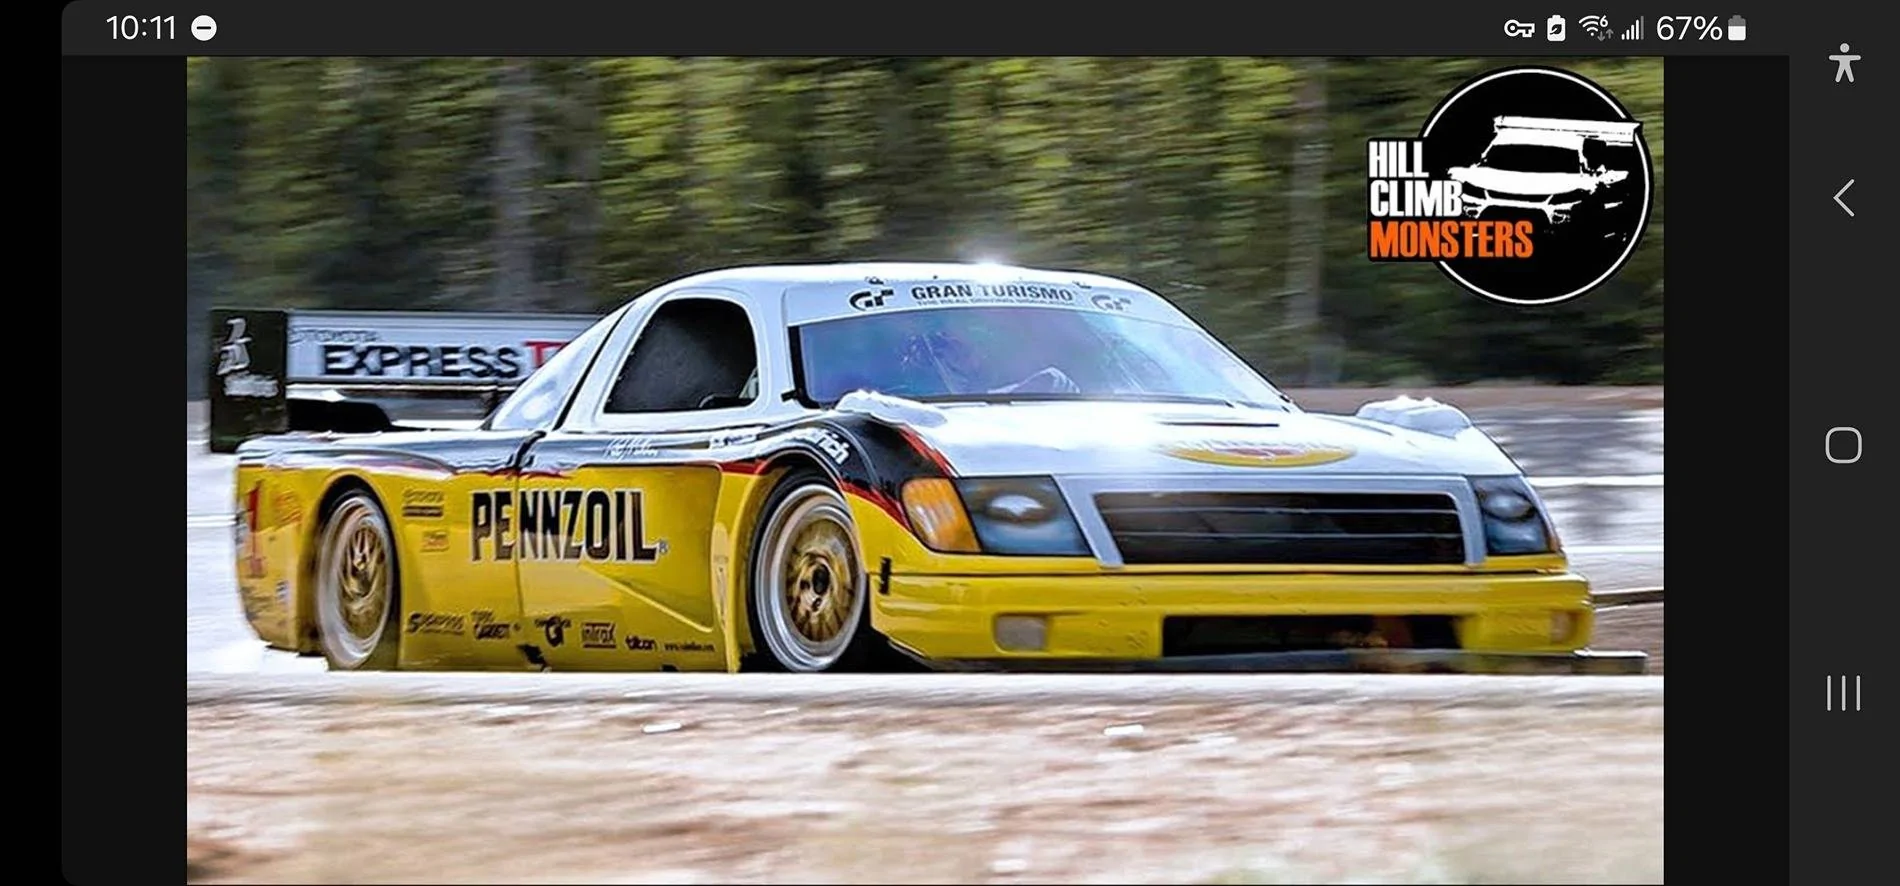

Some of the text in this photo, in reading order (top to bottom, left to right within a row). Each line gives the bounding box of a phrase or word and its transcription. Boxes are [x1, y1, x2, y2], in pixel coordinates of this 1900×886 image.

[106, 15, 175, 40] 10:11
[1656, 15, 1723, 41] 67%
[910, 284, 974, 300] GRAN
[976, 283, 1074, 302] TURISMO
[323, 343, 521, 379] EXPRESS
[470, 489, 658, 562] PENNZOIL
